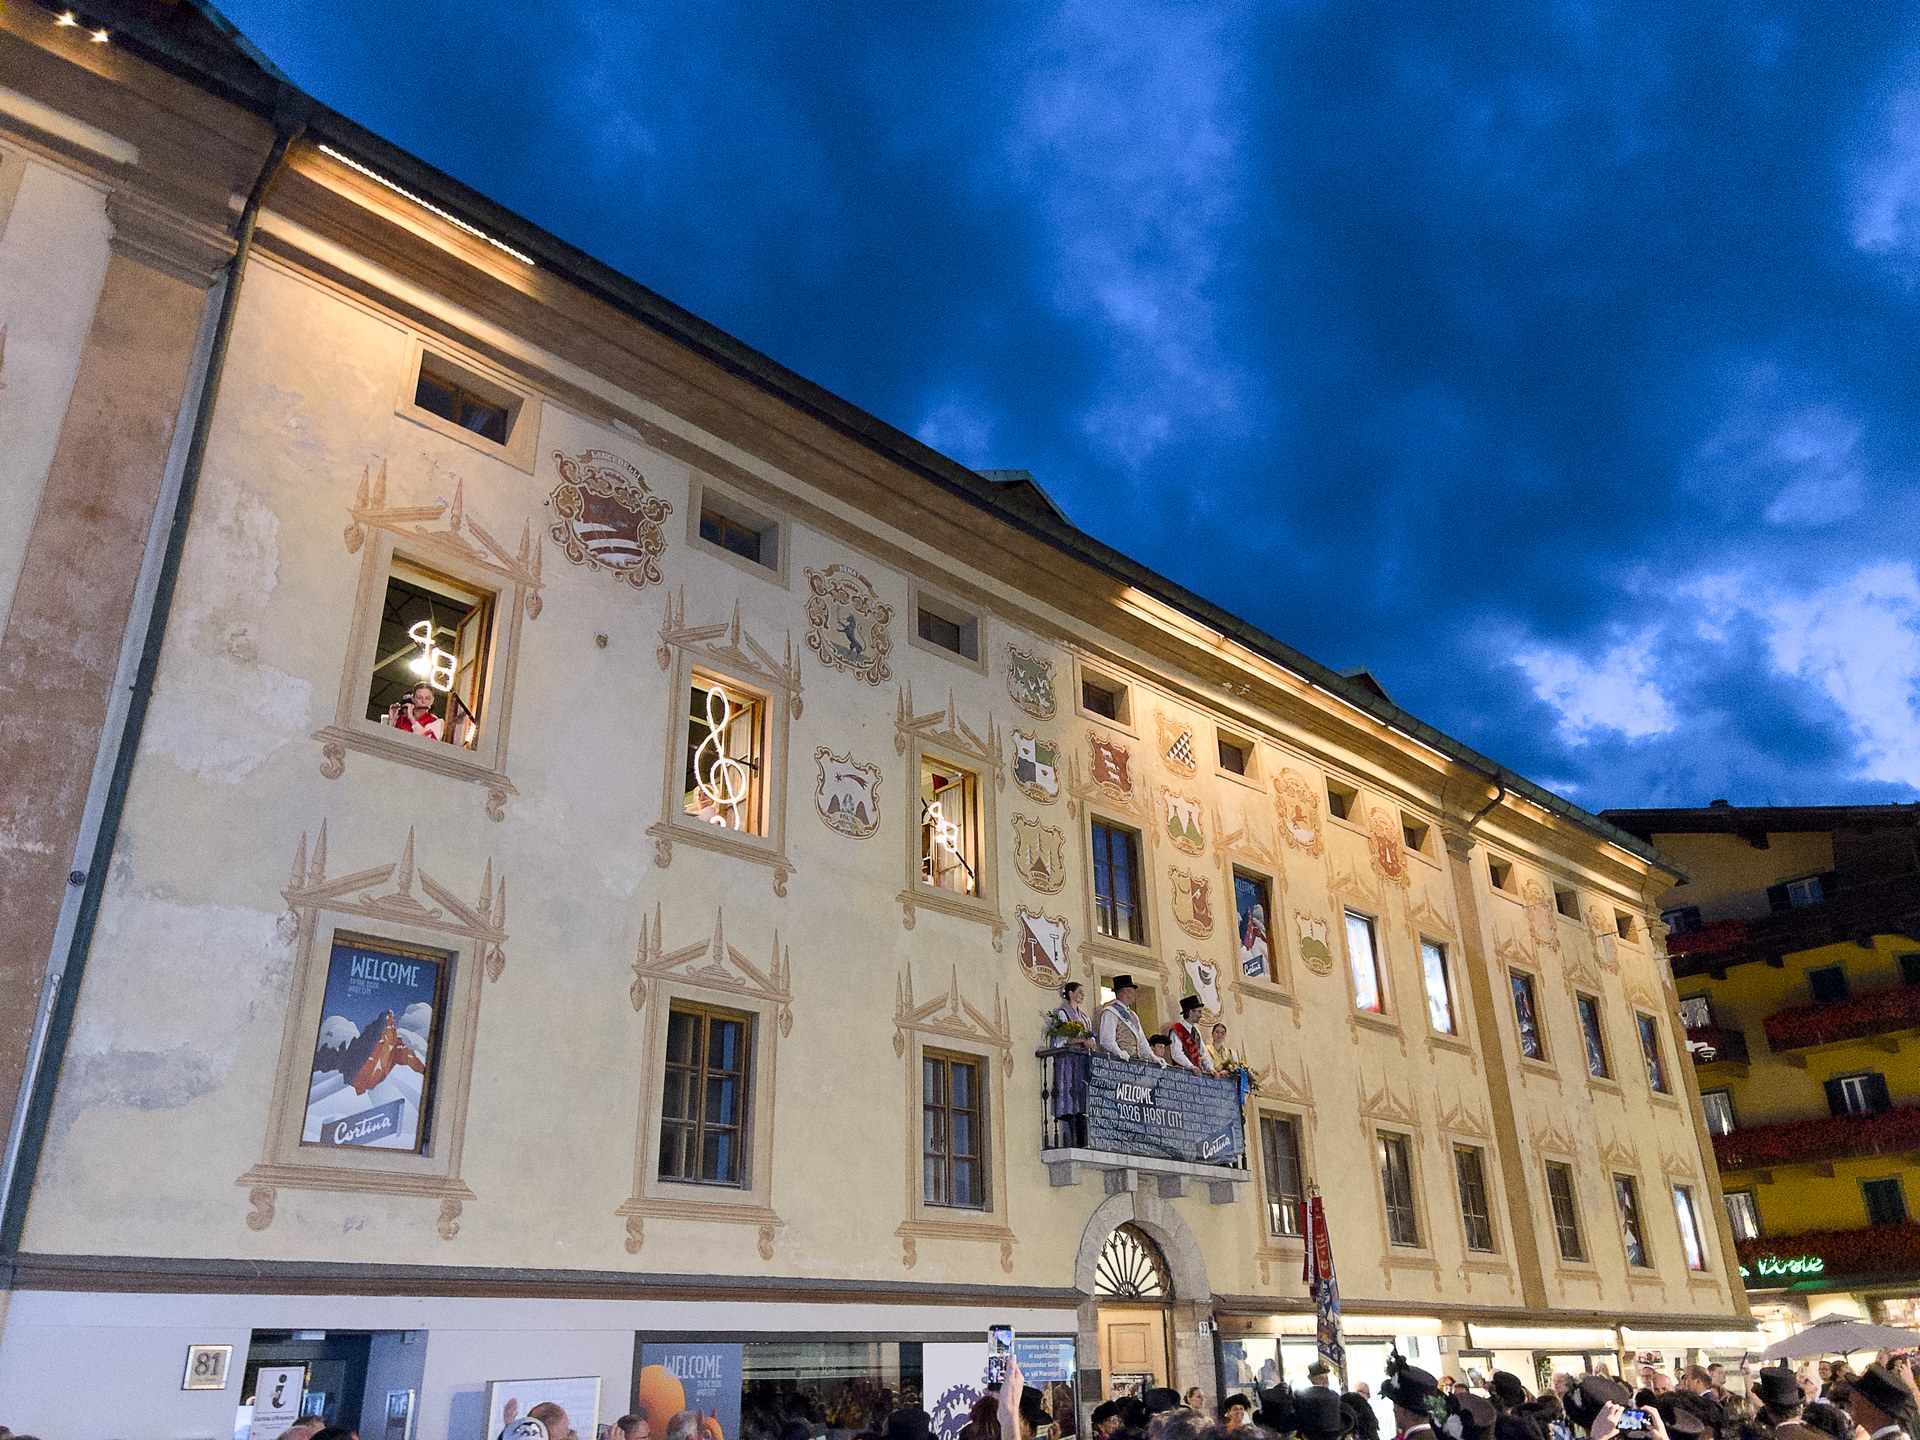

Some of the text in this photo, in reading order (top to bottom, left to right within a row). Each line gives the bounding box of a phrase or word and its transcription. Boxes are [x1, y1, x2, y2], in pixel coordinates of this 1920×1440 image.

[350, 955, 420, 988] WELCOME
[1116, 1083, 1154, 1105] WELCOME
[1118, 1103, 1140, 1123] 2026
[1143, 1107, 1167, 1126] HOST
[1168, 1110, 1183, 1128] CITY
[334, 1113, 392, 1145] Cortina
[1202, 1134, 1231, 1160] Cortina
[195, 1352, 221, 1376] 81
[663, 1355, 722, 1379] WELCOME
